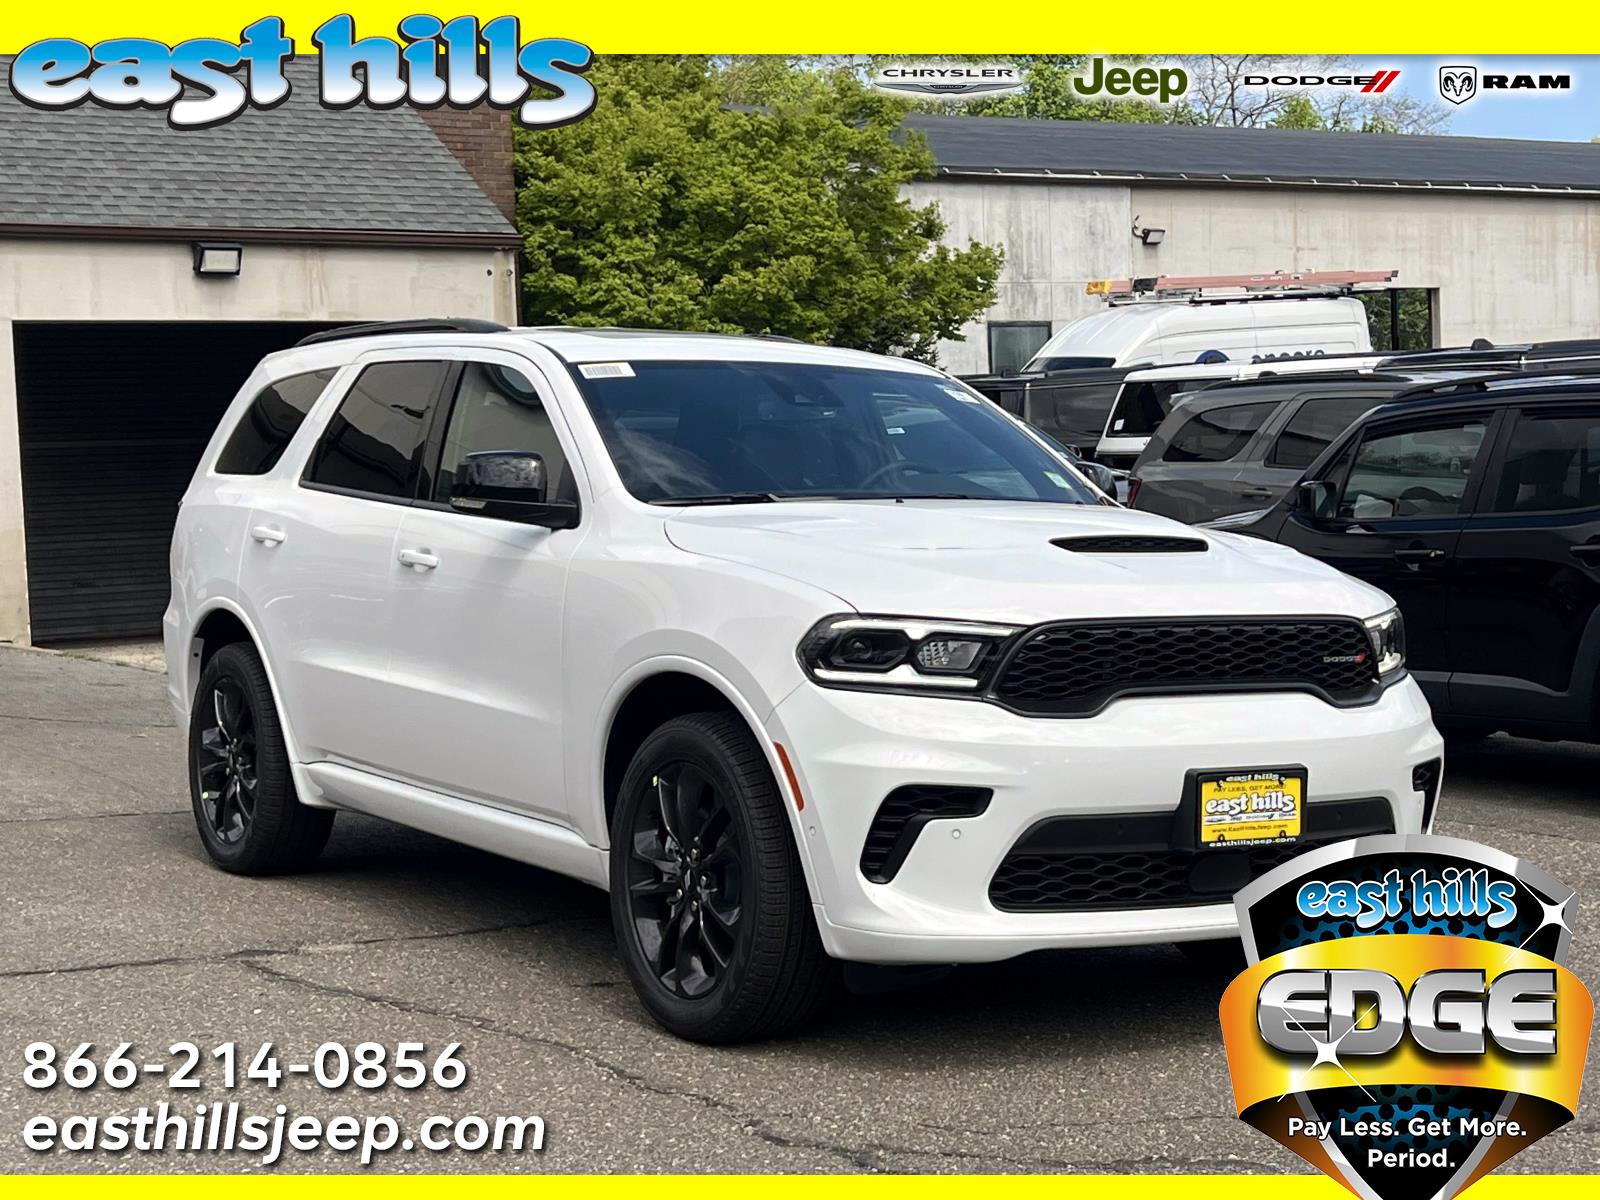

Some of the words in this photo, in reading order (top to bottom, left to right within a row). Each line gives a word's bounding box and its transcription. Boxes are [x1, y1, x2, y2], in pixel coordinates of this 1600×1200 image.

[1205, 793, 1248, 815] east
[1250, 791, 1295, 812] hills
[1209, 836, 1296, 848] easthillsjeep.com
